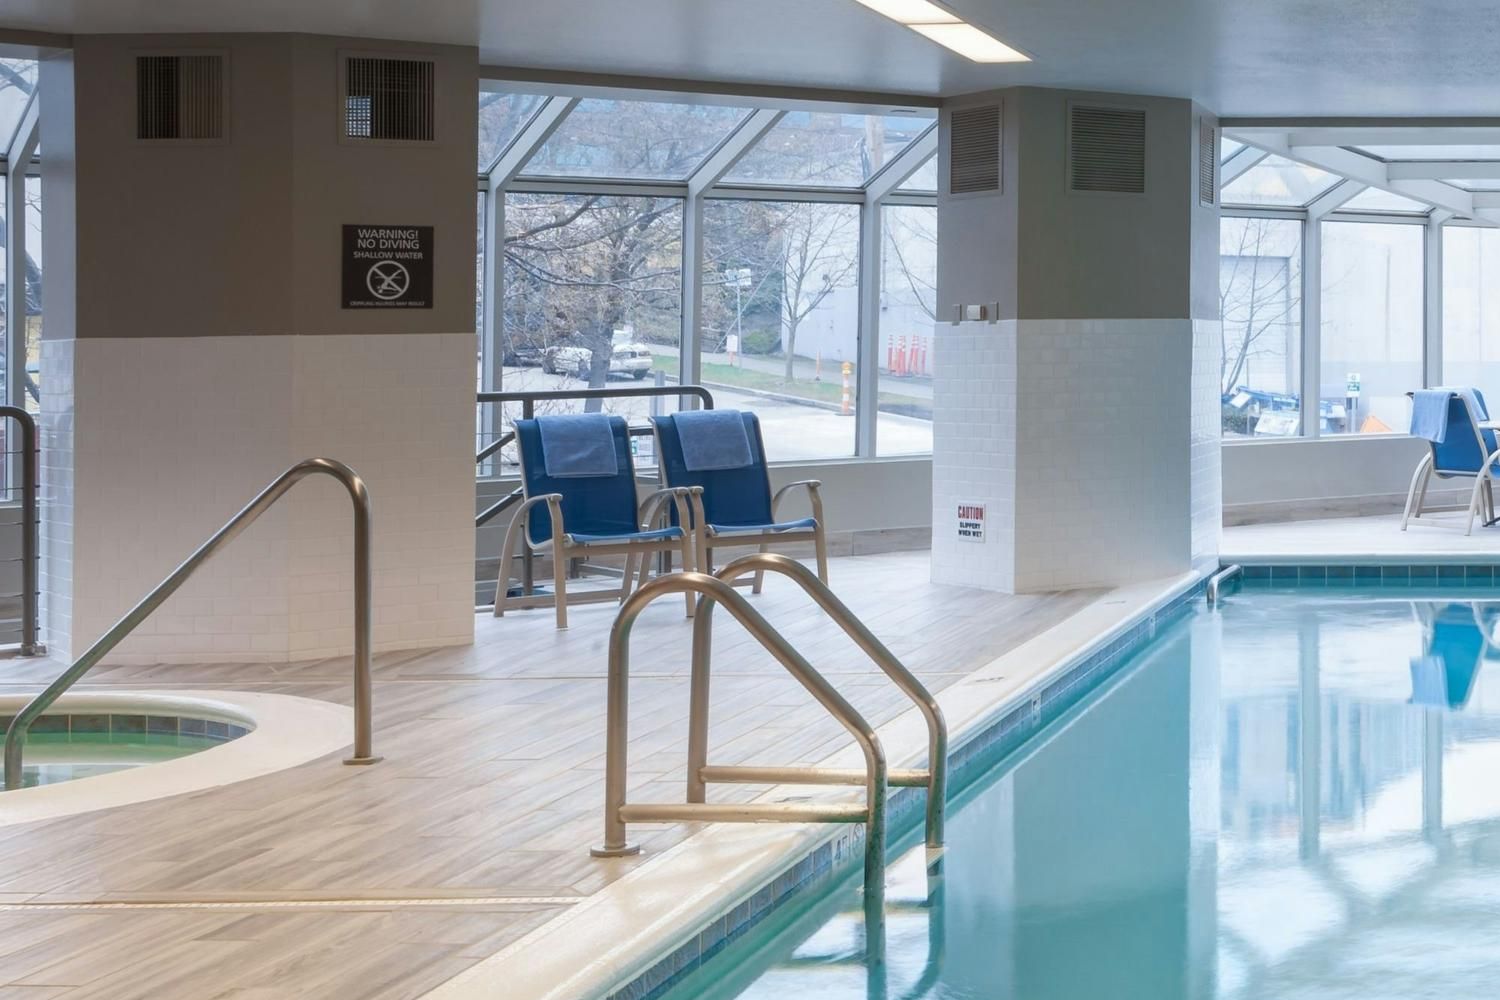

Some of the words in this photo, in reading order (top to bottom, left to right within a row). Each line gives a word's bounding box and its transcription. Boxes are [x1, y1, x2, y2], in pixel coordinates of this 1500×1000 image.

[358, 229, 418, 239] WARNING!
[357, 239, 376, 249] NO
[379, 239, 420, 249] DIVING
[353, 251, 393, 259] SHALLOW
[395, 251, 423, 260] WATER
[958, 505, 984, 520] CAUTION
[959, 521, 981, 529] SLIPPERY
